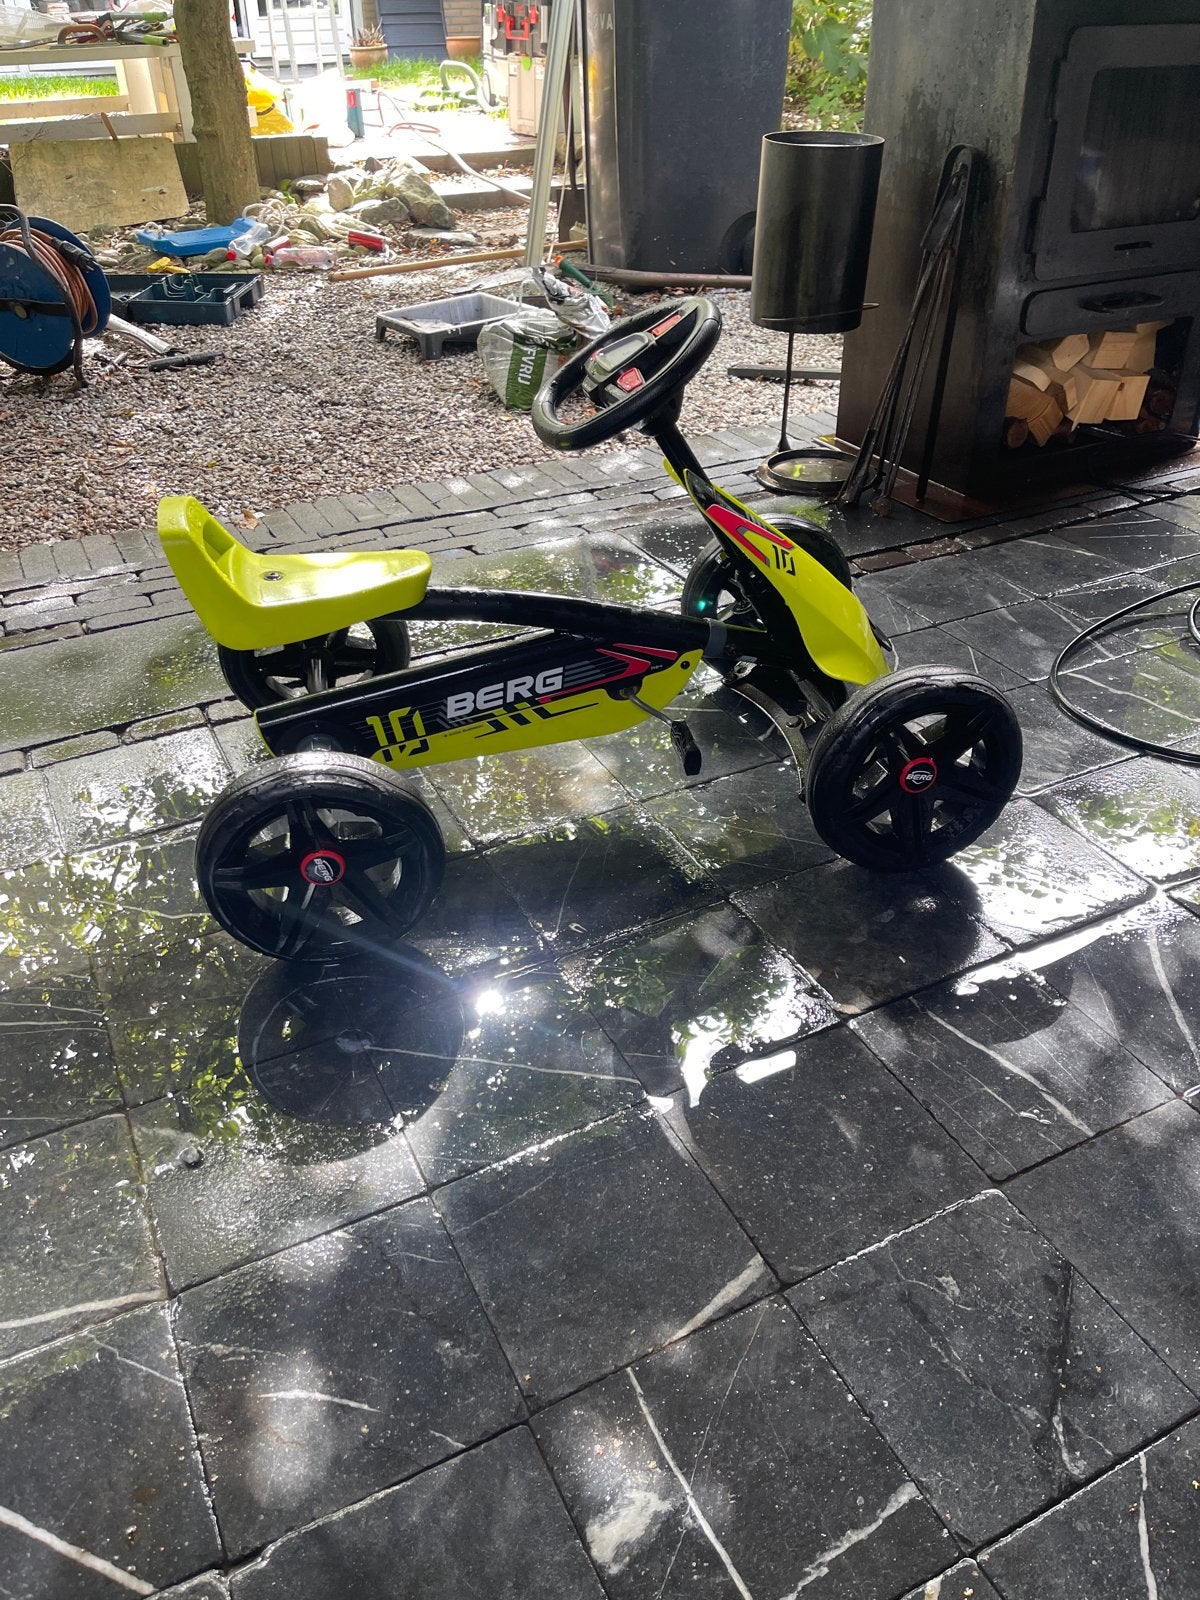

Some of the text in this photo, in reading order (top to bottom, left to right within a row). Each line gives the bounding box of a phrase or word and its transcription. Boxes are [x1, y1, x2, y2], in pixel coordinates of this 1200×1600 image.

[447, 666, 564, 719] BERG
[906, 773, 933, 781] BERG
[313, 858, 333, 882] BERG
